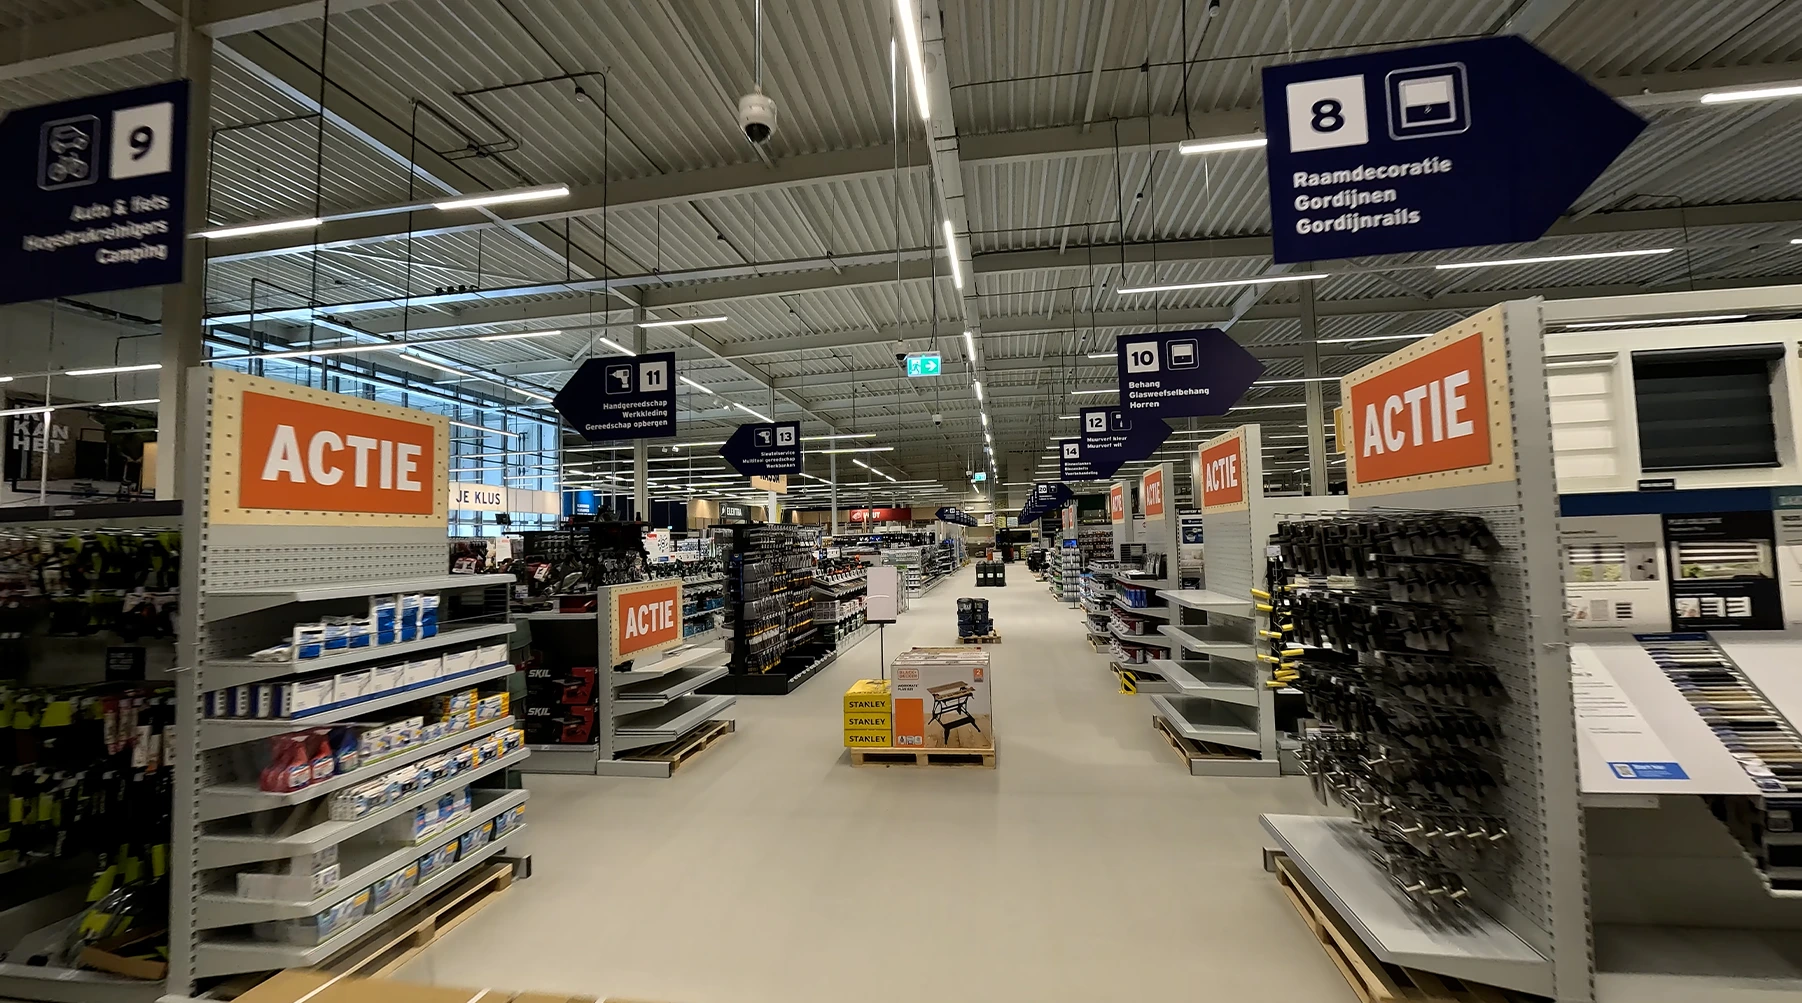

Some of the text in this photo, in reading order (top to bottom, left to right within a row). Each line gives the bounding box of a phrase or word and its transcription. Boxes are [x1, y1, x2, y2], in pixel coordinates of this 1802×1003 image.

[1310, 98, 1346, 133] 8
[129, 125, 154, 160] 9
[1293, 156, 1453, 188] Raamdecoratie
[1294, 188, 1397, 211] Gordijnen
[1296, 207, 1421, 234] Gordijnrails
[95, 242, 168, 264] Camping
[1131, 350, 1154, 366] 10
[646, 370, 660, 385] 11
[1128, 381, 1160, 389] Behang
[1129, 388, 1210, 399] Glasweefselbehang
[603, 400, 668, 411] Handgereedschap
[1130, 401, 1160, 409] Horren
[622, 409, 668, 419] Werkkleding
[1363, 369, 1474, 458] ACTIE
[13, 419, 69, 440] KAN
[585, 419, 668, 431] Gereedschap opbergen
[1089, 418, 1103, 428] 12
[12, 435, 65, 454] HET
[779, 432, 792, 442] 13
[260, 423, 422, 492] ACTIE
[1065, 447, 1077, 455] 14
[1205, 453, 1238, 493] ACTIE
[455, 490, 501, 505] JE KLUS
[1146, 481, 1161, 506] ACTIE
[863, 511, 881, 519] HUT
[625, 600, 673, 639] ACTIE
[528, 669, 551, 678] SKIL
[527, 707, 551, 716] SKIL
[849, 700, 886, 708] STANLEY
[849, 718, 886, 726] STANLEY
[849, 735, 886, 743] STANLEY
